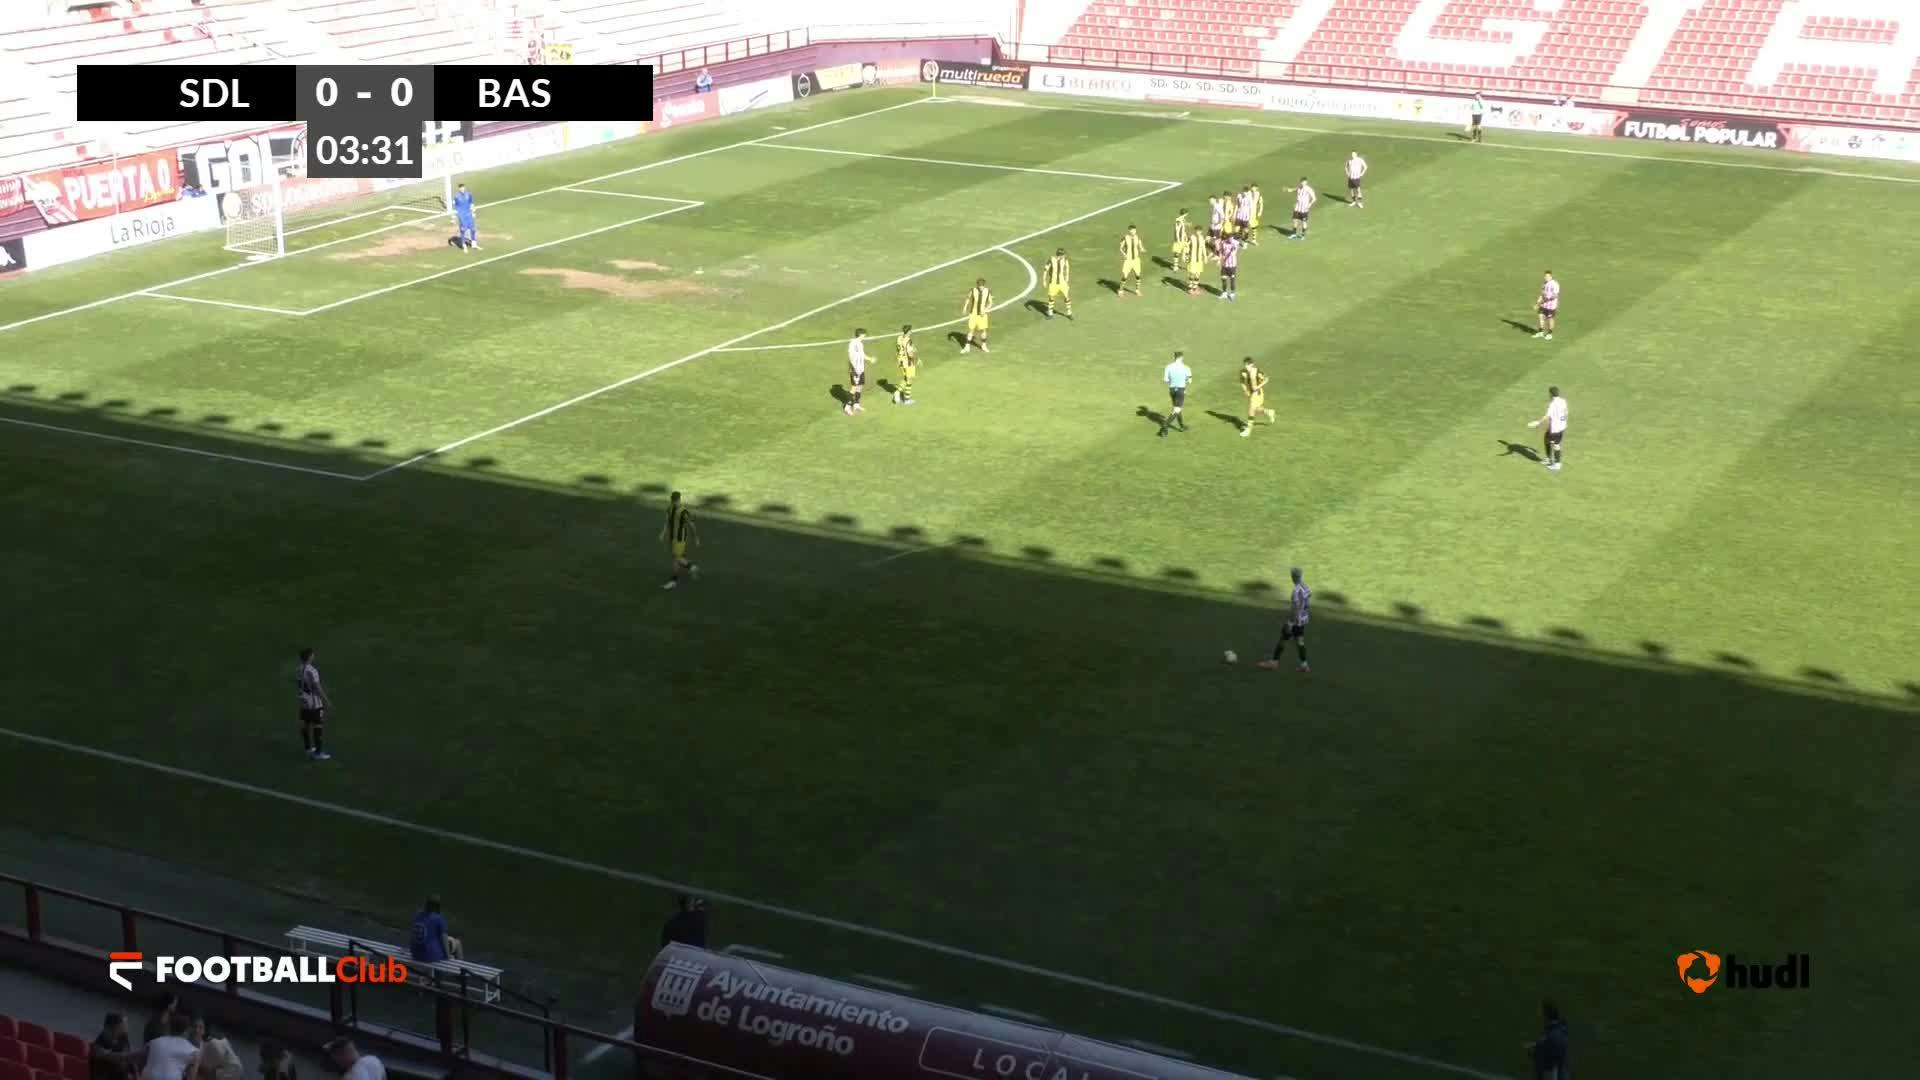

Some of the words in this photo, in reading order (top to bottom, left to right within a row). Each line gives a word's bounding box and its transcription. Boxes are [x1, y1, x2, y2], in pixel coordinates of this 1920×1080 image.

[1624, 121, 1691, 142] FUTBOL
[1694, 126, 1777, 148] POPULAR
[63, 163, 152, 211] PUERTA
[109, 223, 130, 245] La
[132, 215, 176, 238] Rioja
[705, 967, 909, 1034] Ayuntamiento
[697, 996, 732, 1025] de
[737, 1005, 855, 1056] Logroño
